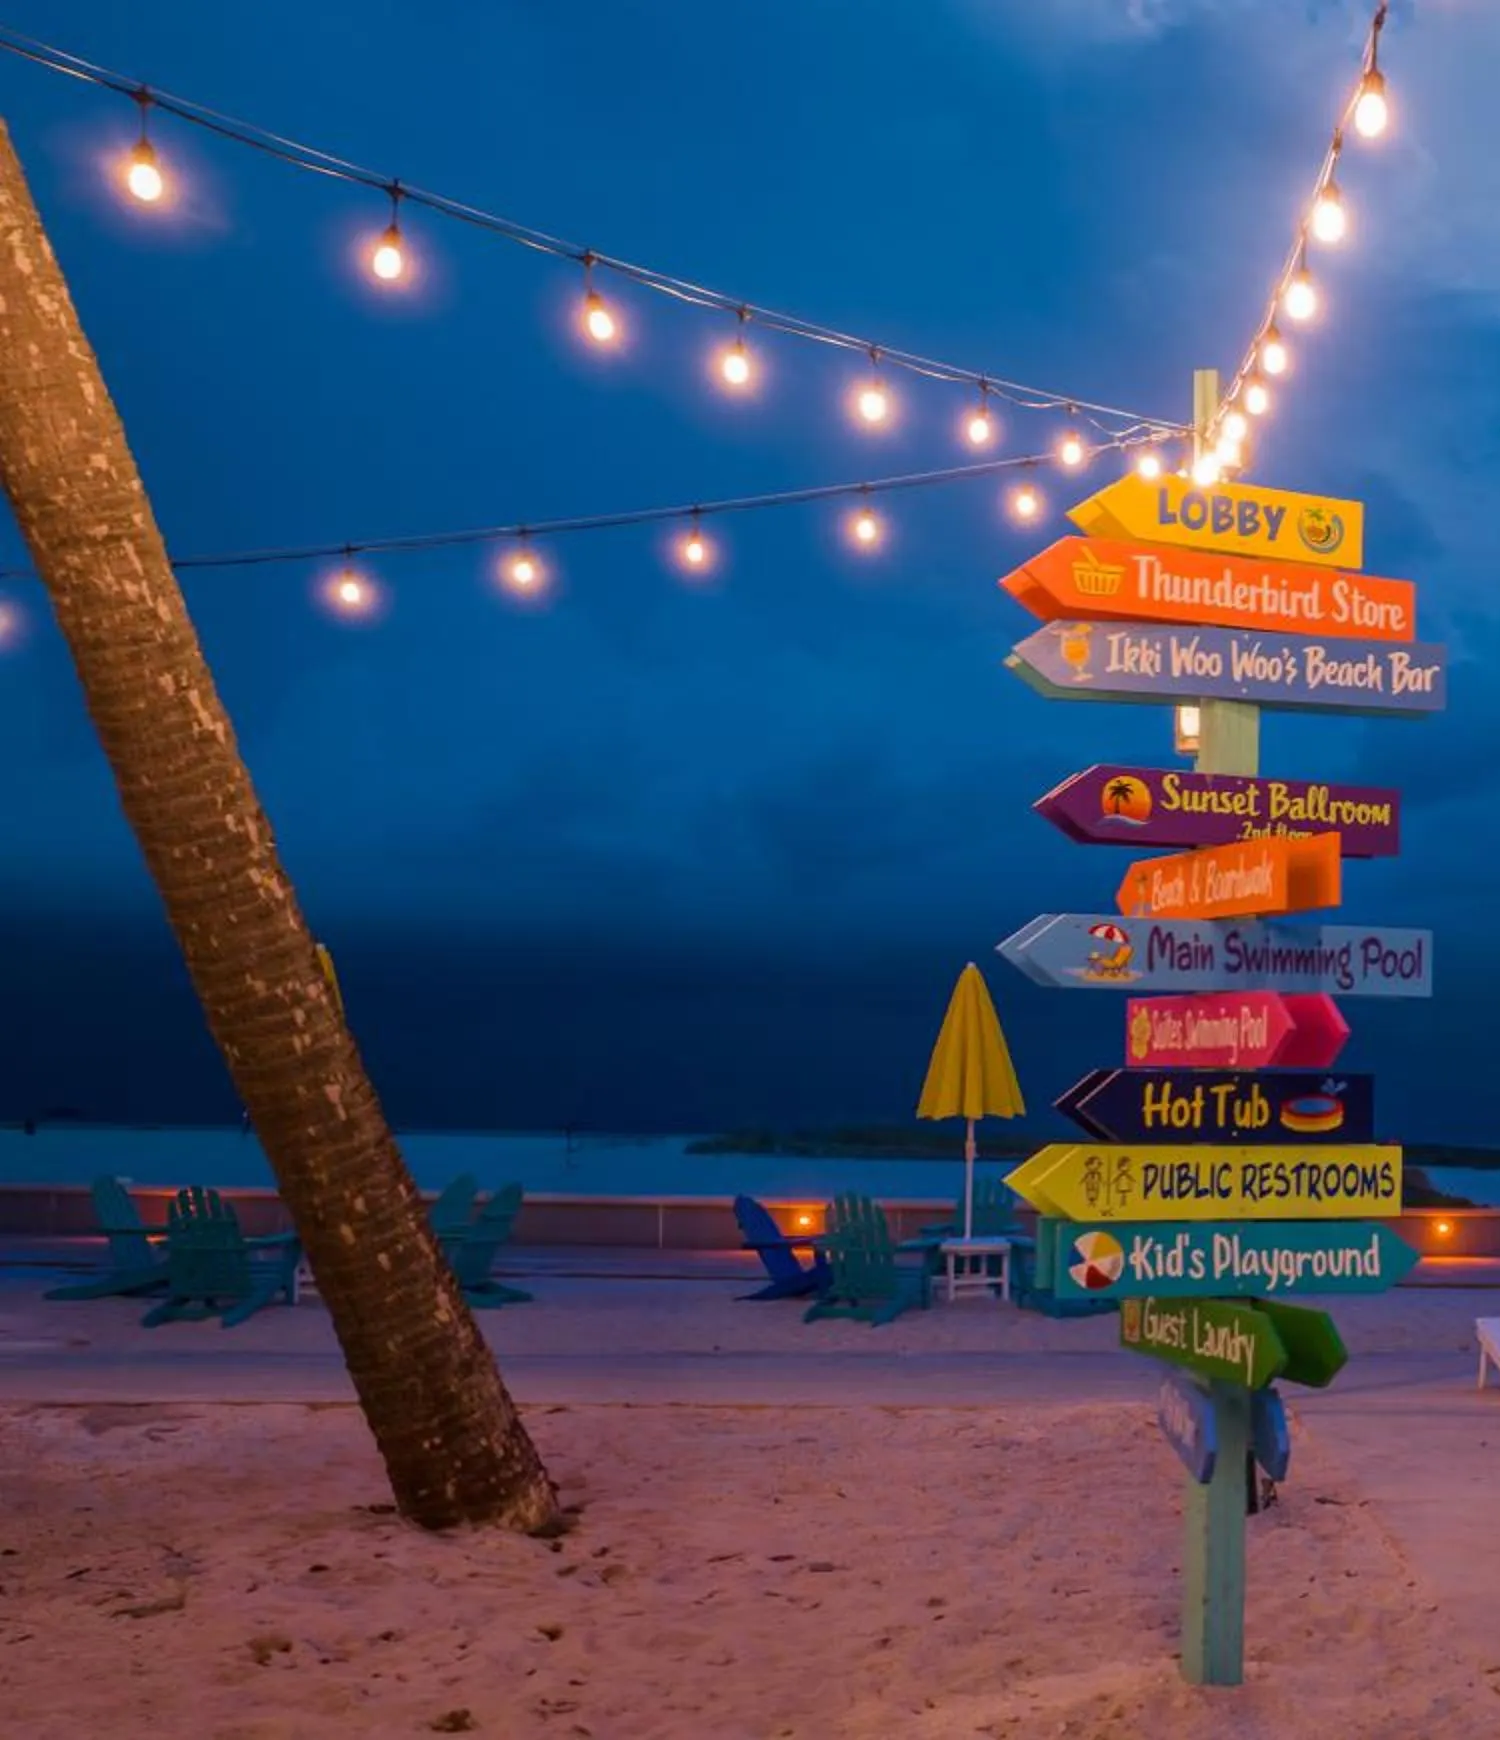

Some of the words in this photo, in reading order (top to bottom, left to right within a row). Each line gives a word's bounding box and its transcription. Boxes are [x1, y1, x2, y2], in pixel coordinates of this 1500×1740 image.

[1157, 487, 1286, 540] LOBBY
[1133, 554, 1323, 620] Thunderbird
[1331, 580, 1406, 631] Store
[1105, 632, 1162, 677] Ikki
[1169, 636, 1222, 678] Woo
[1232, 638, 1297, 686] Woo's
[1303, 645, 1383, 692] Beach
[1390, 652, 1440, 694] Bar
[1160, 773, 1261, 818] Sunset
[1268, 783, 1391, 827] Ballroom
[1152, 864, 1185, 912] Beach
[1190, 859, 1200, 904] &
[1205, 850, 1274, 904] Boardwalk
[1147, 925, 1215, 974] Main
[1223, 929, 1353, 990] Swimming
[1360, 936, 1422, 979] Pool
[1152, 1009, 1183, 1050] Suites
[1185, 1007, 1238, 1065] Swimming
[1240, 1005, 1268, 1049] Pool
[1142, 1082, 1206, 1128] Hot
[1210, 1083, 1270, 1128] Tub
[1141, 1161, 1231, 1200] PUBLIC
[1241, 1161, 1395, 1200] RESTROOMS
[1130, 1232, 1206, 1281] Kid's
[1213, 1233, 1381, 1291] Playground
[1143, 1296, 1188, 1349] Guest
[1193, 1307, 1255, 1386] Laundry
